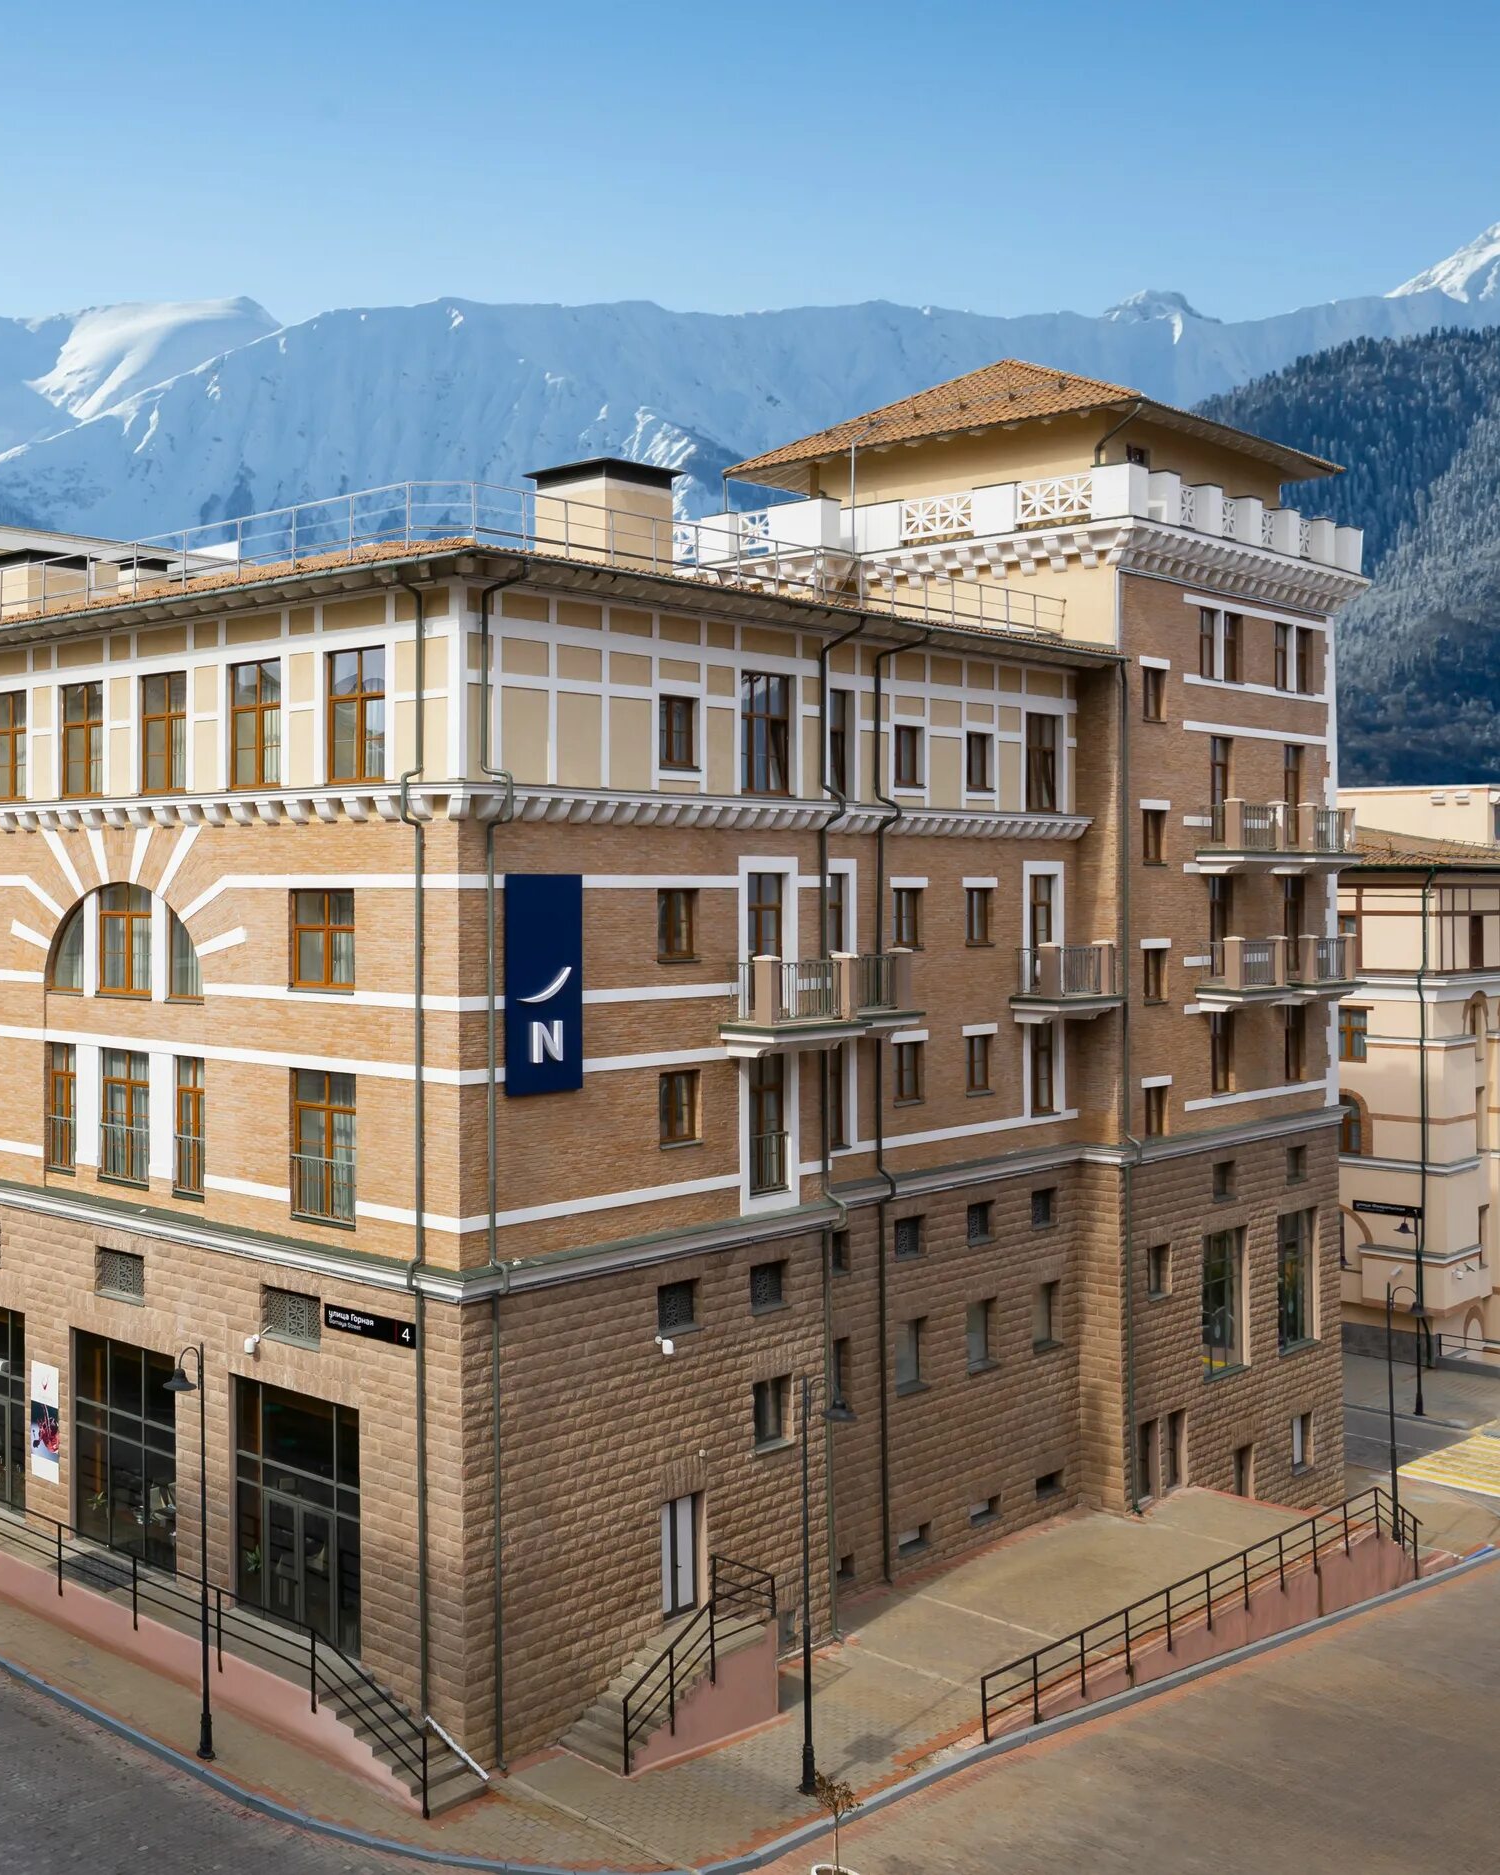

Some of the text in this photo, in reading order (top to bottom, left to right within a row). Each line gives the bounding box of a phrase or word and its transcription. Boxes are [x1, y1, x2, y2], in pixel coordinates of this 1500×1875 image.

[529, 1020, 563, 1063] N
[328, 1310, 374, 1326] улица Горная
[401, 1328, 410, 1341] 4
